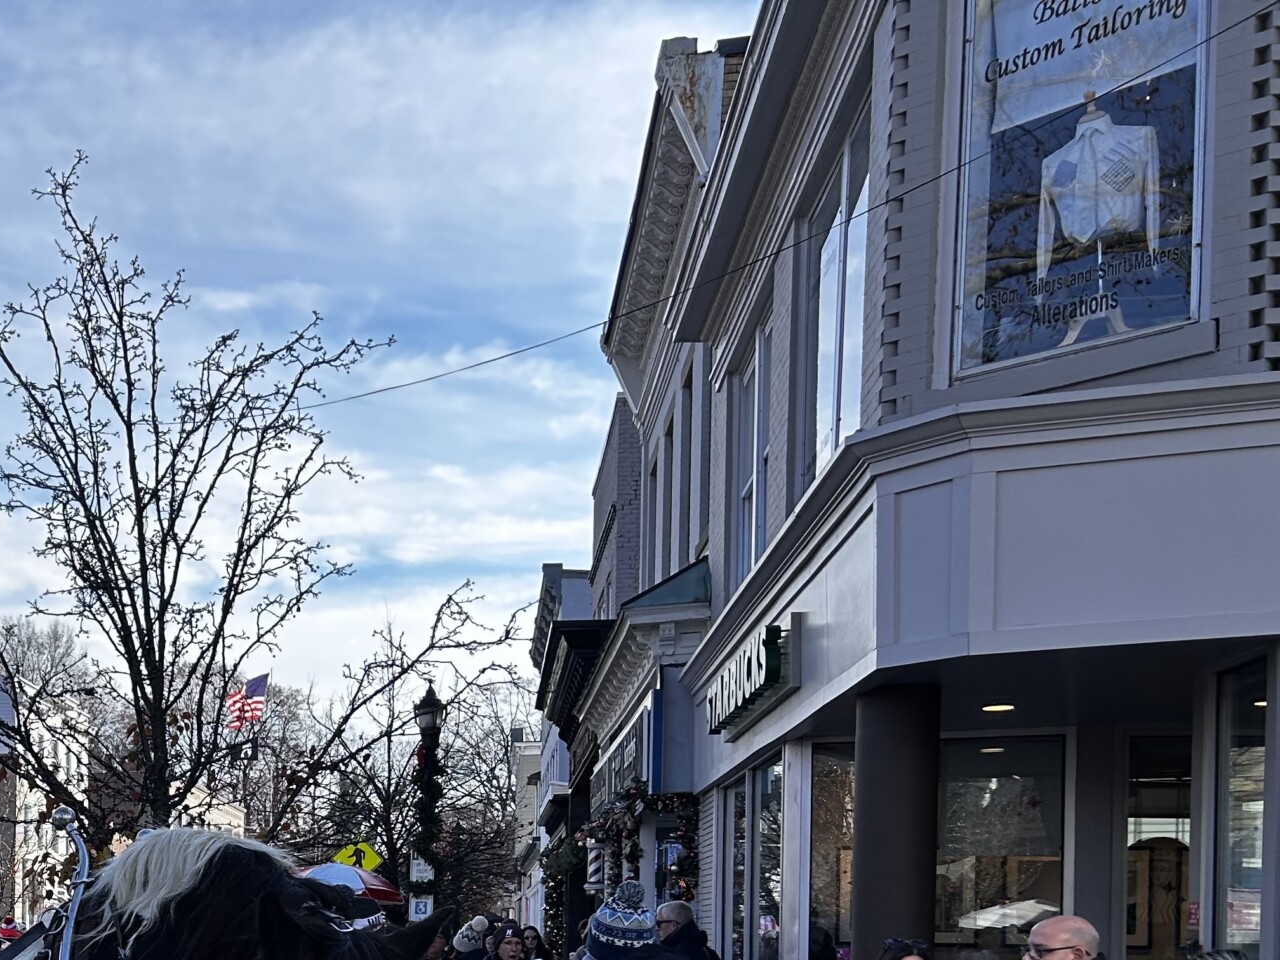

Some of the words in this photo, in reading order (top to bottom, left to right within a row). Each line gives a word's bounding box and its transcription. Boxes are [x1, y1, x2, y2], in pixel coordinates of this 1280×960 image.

[985, 38, 1065, 83] Custom
[1071, 0, 1188, 50] Tailoring
[975, 289, 1019, 311] Custom
[1025, 276, 1063, 297] Tailors
[1070, 266, 1092, 287] and
[1098, 257, 1132, 279] Shirt
[1134, 247, 1180, 271] Makers
[1031, 290, 1119, 327] Alterations
[706, 625, 767, 735] STARBUCKS
